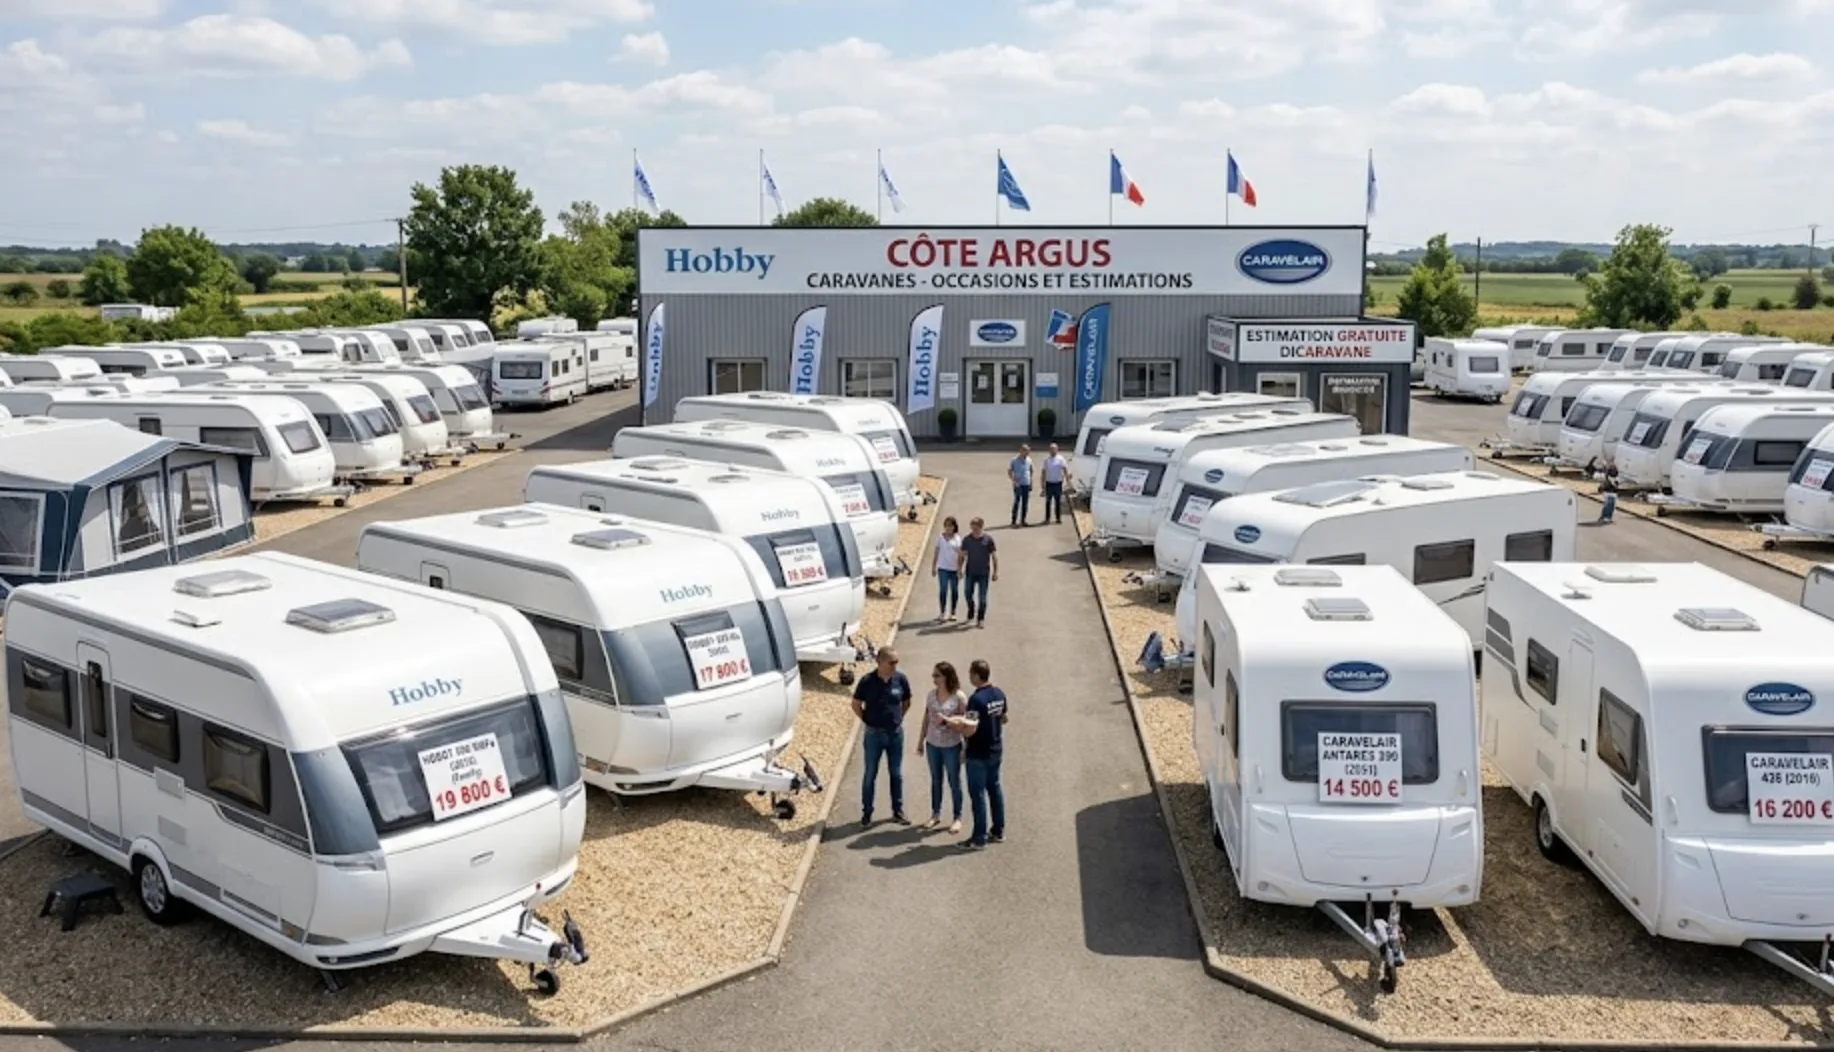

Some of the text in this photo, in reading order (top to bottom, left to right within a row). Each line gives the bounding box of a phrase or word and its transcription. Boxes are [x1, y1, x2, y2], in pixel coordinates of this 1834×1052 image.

[887, 233, 1111, 267] CÔTE ARGUS
[665, 247, 775, 279] Hobby
[807, 273, 917, 288] CARAVANES
[931, 273, 1039, 288] OCCASIONS
[1044, 273, 1065, 288] ET
[1069, 273, 1193, 288] ESTIMATIONS
[1246, 329, 1334, 342] ESTIMATION
[1337, 330, 1407, 342] GRATUITE
[796, 325, 820, 394] Hobby
[914, 326, 938, 396] Hobby
[1280, 346, 1372, 358] DICARAVANE
[660, 584, 713, 603] Hobby
[388, 677, 463, 706] Hobby
[1323, 736, 1397, 749] CARAVELAIR
[1323, 750, 1376, 762] ANTARES
[1750, 757, 1829, 770] CARAVELAIR
[436, 790, 457, 811] 19
[495, 775, 505, 794] €
[1324, 779, 1398, 797] 14 500 €
[1755, 799, 1833, 819] 16 200 €
